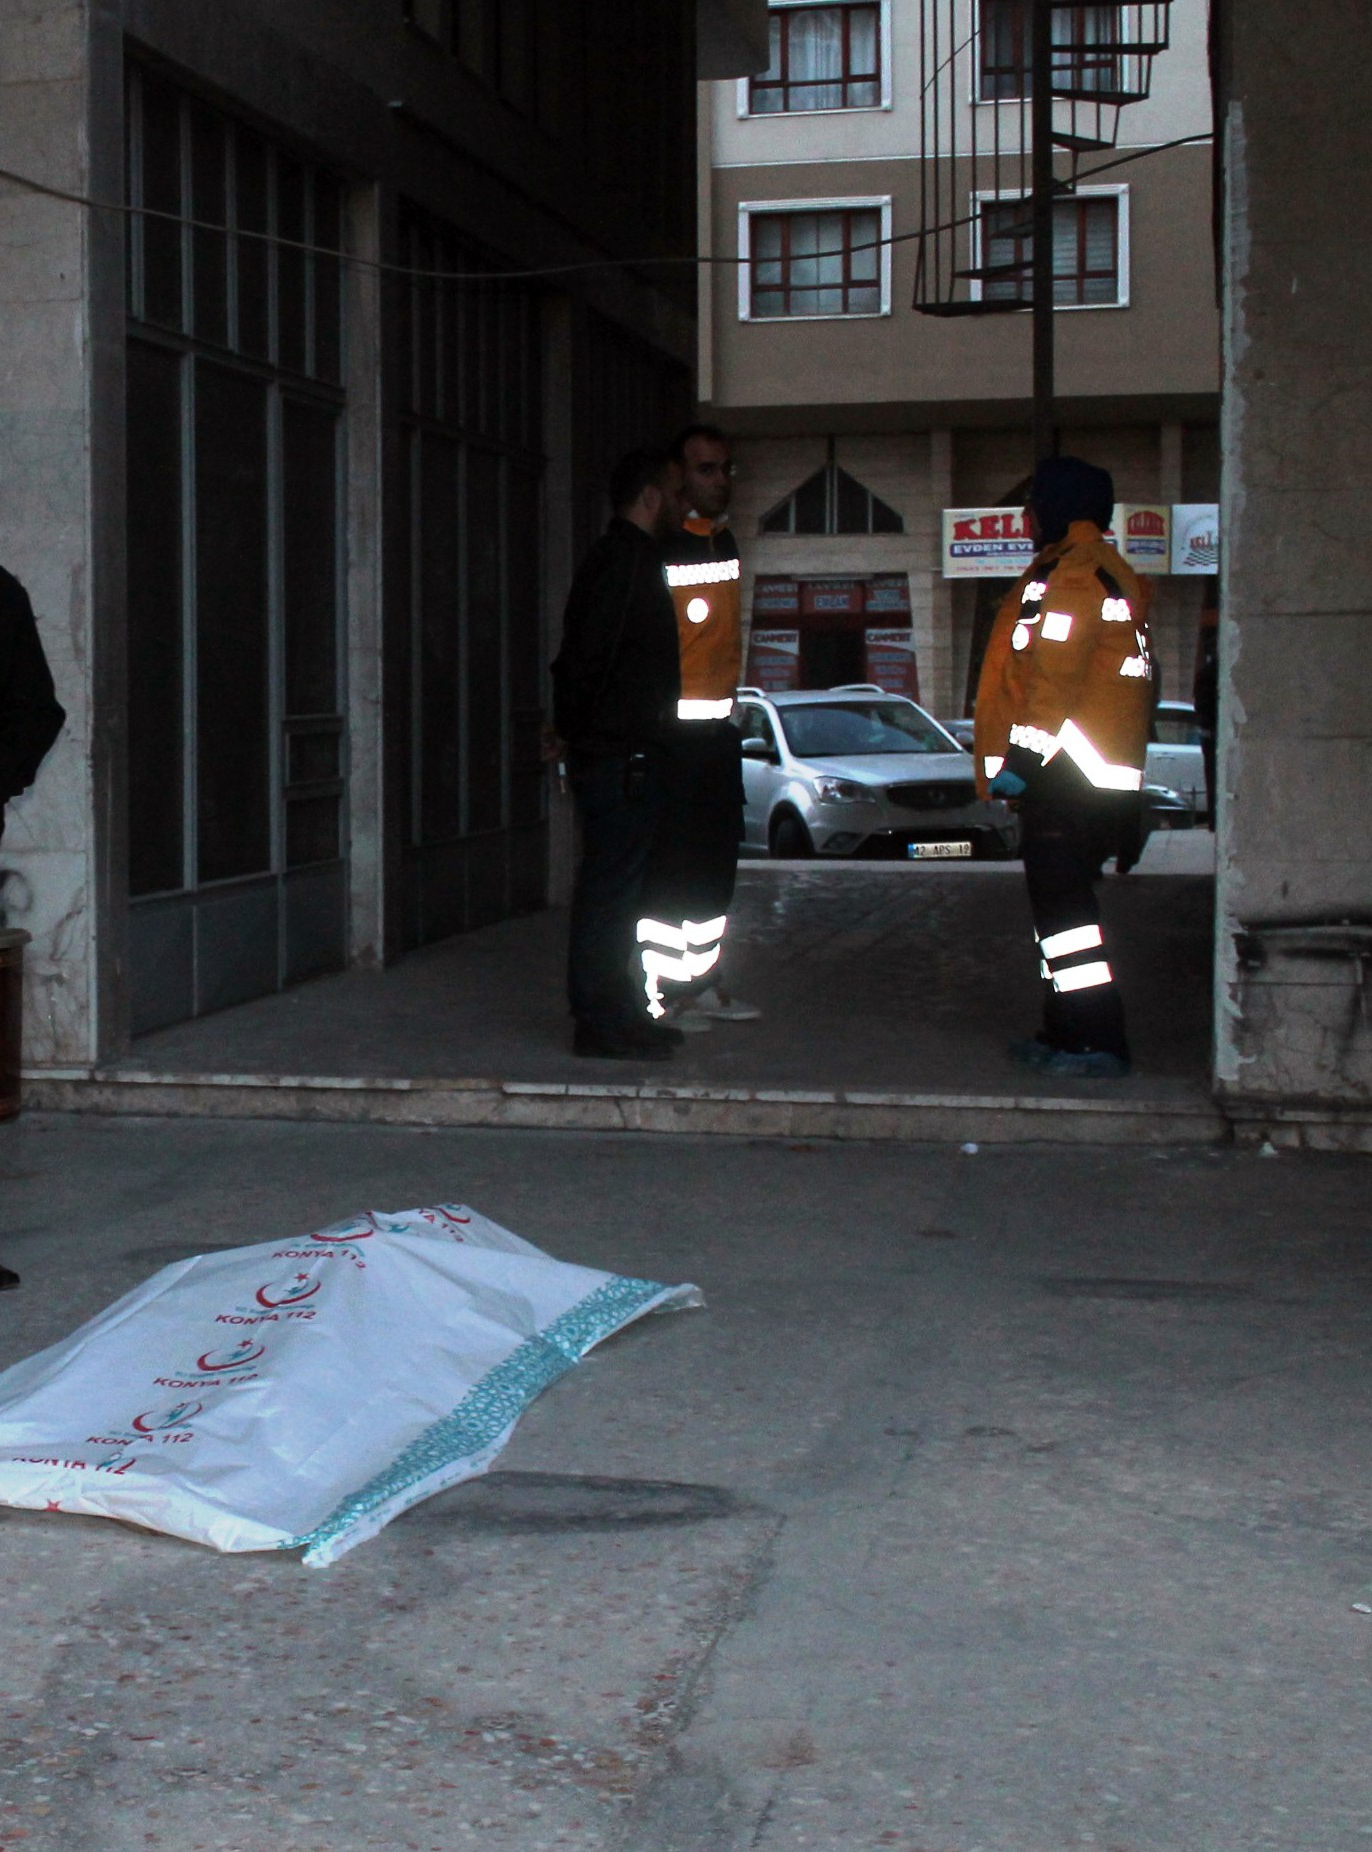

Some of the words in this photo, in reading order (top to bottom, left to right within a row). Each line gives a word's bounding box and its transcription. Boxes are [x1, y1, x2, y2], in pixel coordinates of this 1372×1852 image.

[953, 543, 1003, 555] EVDEN
[271, 1249, 335, 1259] KONYA
[215, 1313, 279, 1325] KONYA
[286, 1310, 317, 1320] 112
[153, 1377, 221, 1388] KONYA
[162, 1432, 194, 1443] 112
